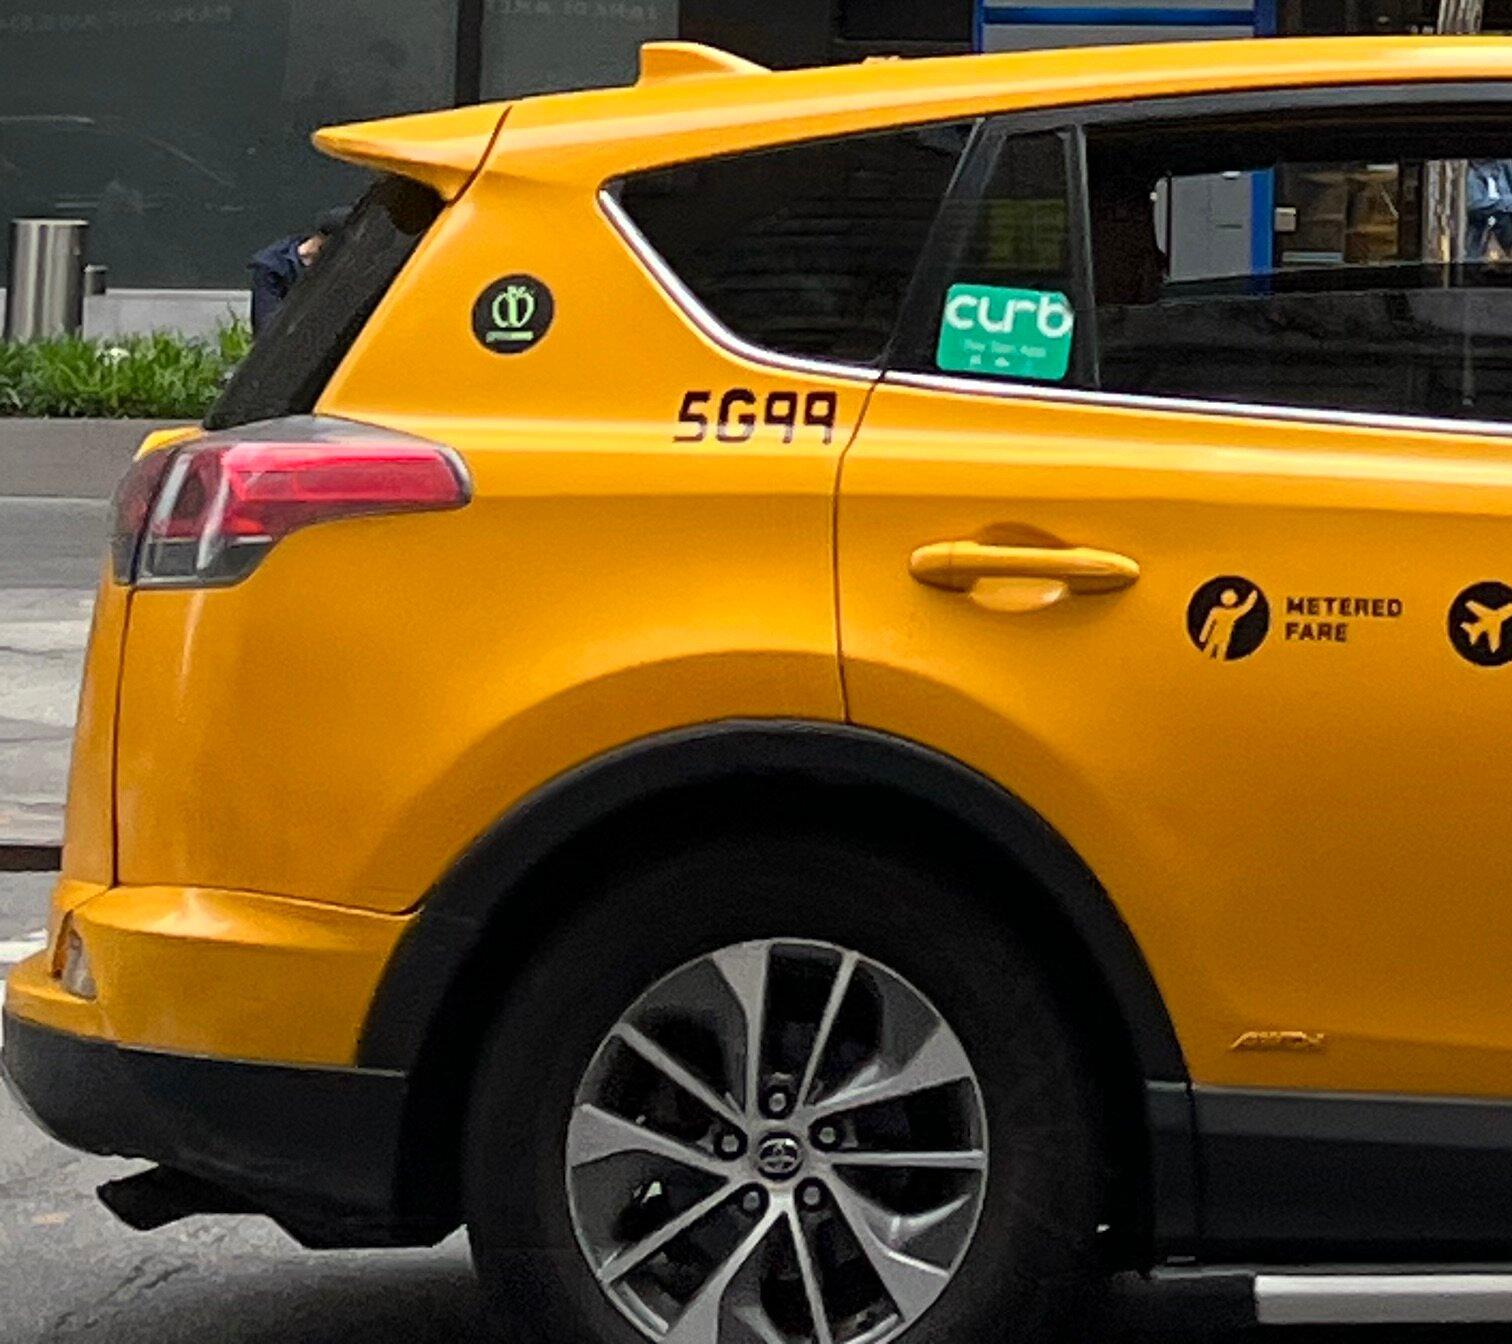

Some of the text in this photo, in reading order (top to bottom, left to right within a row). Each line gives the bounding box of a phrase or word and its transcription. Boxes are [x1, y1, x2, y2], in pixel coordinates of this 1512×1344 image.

[945, 294, 1074, 339] curb
[672, 388, 838, 445] 5G99
[1285, 597, 1403, 618] METERED
[1285, 622, 1348, 642] FARE
